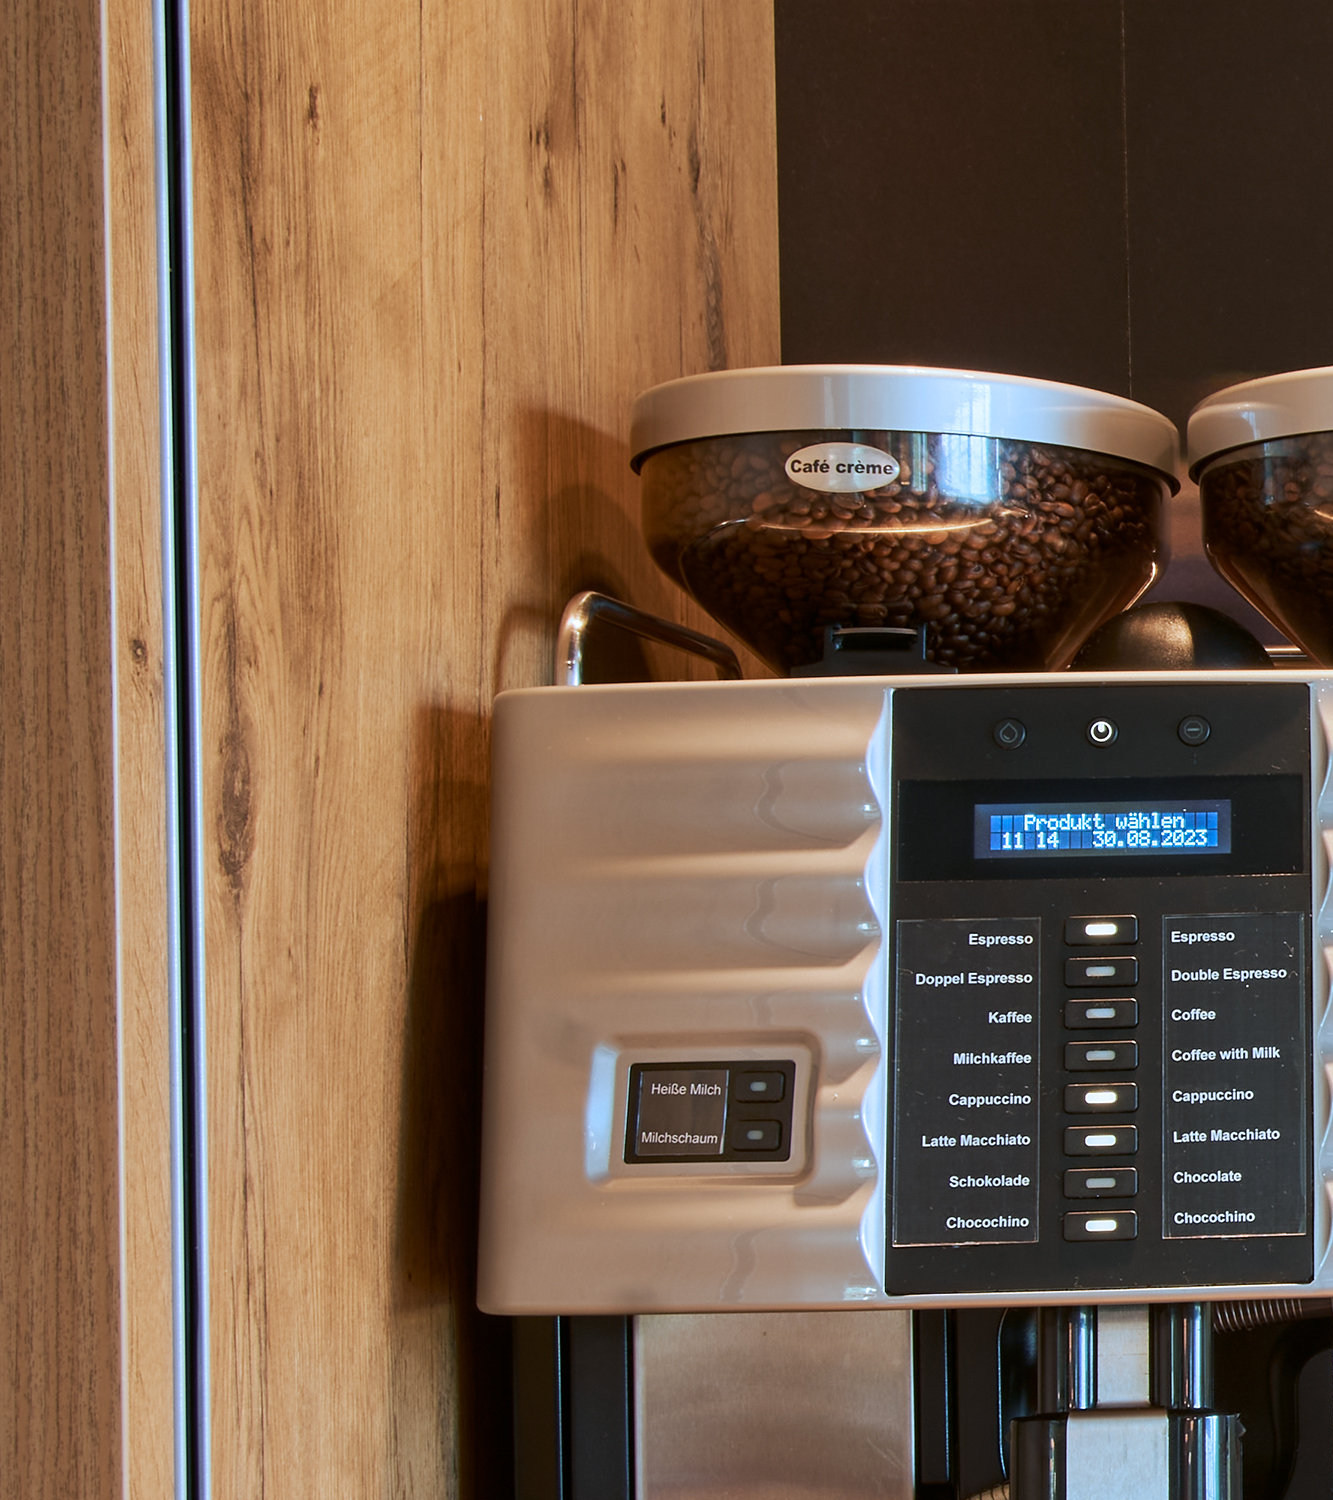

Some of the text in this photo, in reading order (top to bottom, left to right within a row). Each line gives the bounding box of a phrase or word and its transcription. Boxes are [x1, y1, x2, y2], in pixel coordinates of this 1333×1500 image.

[790, 459, 893, 475] Café crème
[1024, 812, 1185, 831] Produkt wählen
[1002, 829, 1208, 849] 11 14 30.08.2023
[968, 932, 1034, 948] Espresso
[1170, 930, 1236, 946] Espresso
[915, 971, 1034, 987] Doppel Espresso
[1170, 966, 1288, 983] Double Espresso
[988, 1011, 1033, 1024] Kaffee
[1170, 1008, 1217, 1021] Coffee
[953, 1052, 1033, 1066] Milchkaffee
[1171, 1046, 1281, 1062] Coffee with Milk
[651, 1083, 722, 1096] Heiße Milch
[1171, 1088, 1255, 1105] Cappuccino
[948, 1092, 1032, 1109] Cappuccino
[641, 1131, 718, 1145] Milchschaum
[921, 1133, 1032, 1149] Latte Macchiato
[1172, 1127, 1281, 1144] Latte Macchiato
[948, 1174, 1031, 1189] Schokolade
[1172, 1170, 1243, 1184] Chocolate
[945, 1215, 1031, 1230] Chocochino
[1173, 1210, 1256, 1225] Chocochino
